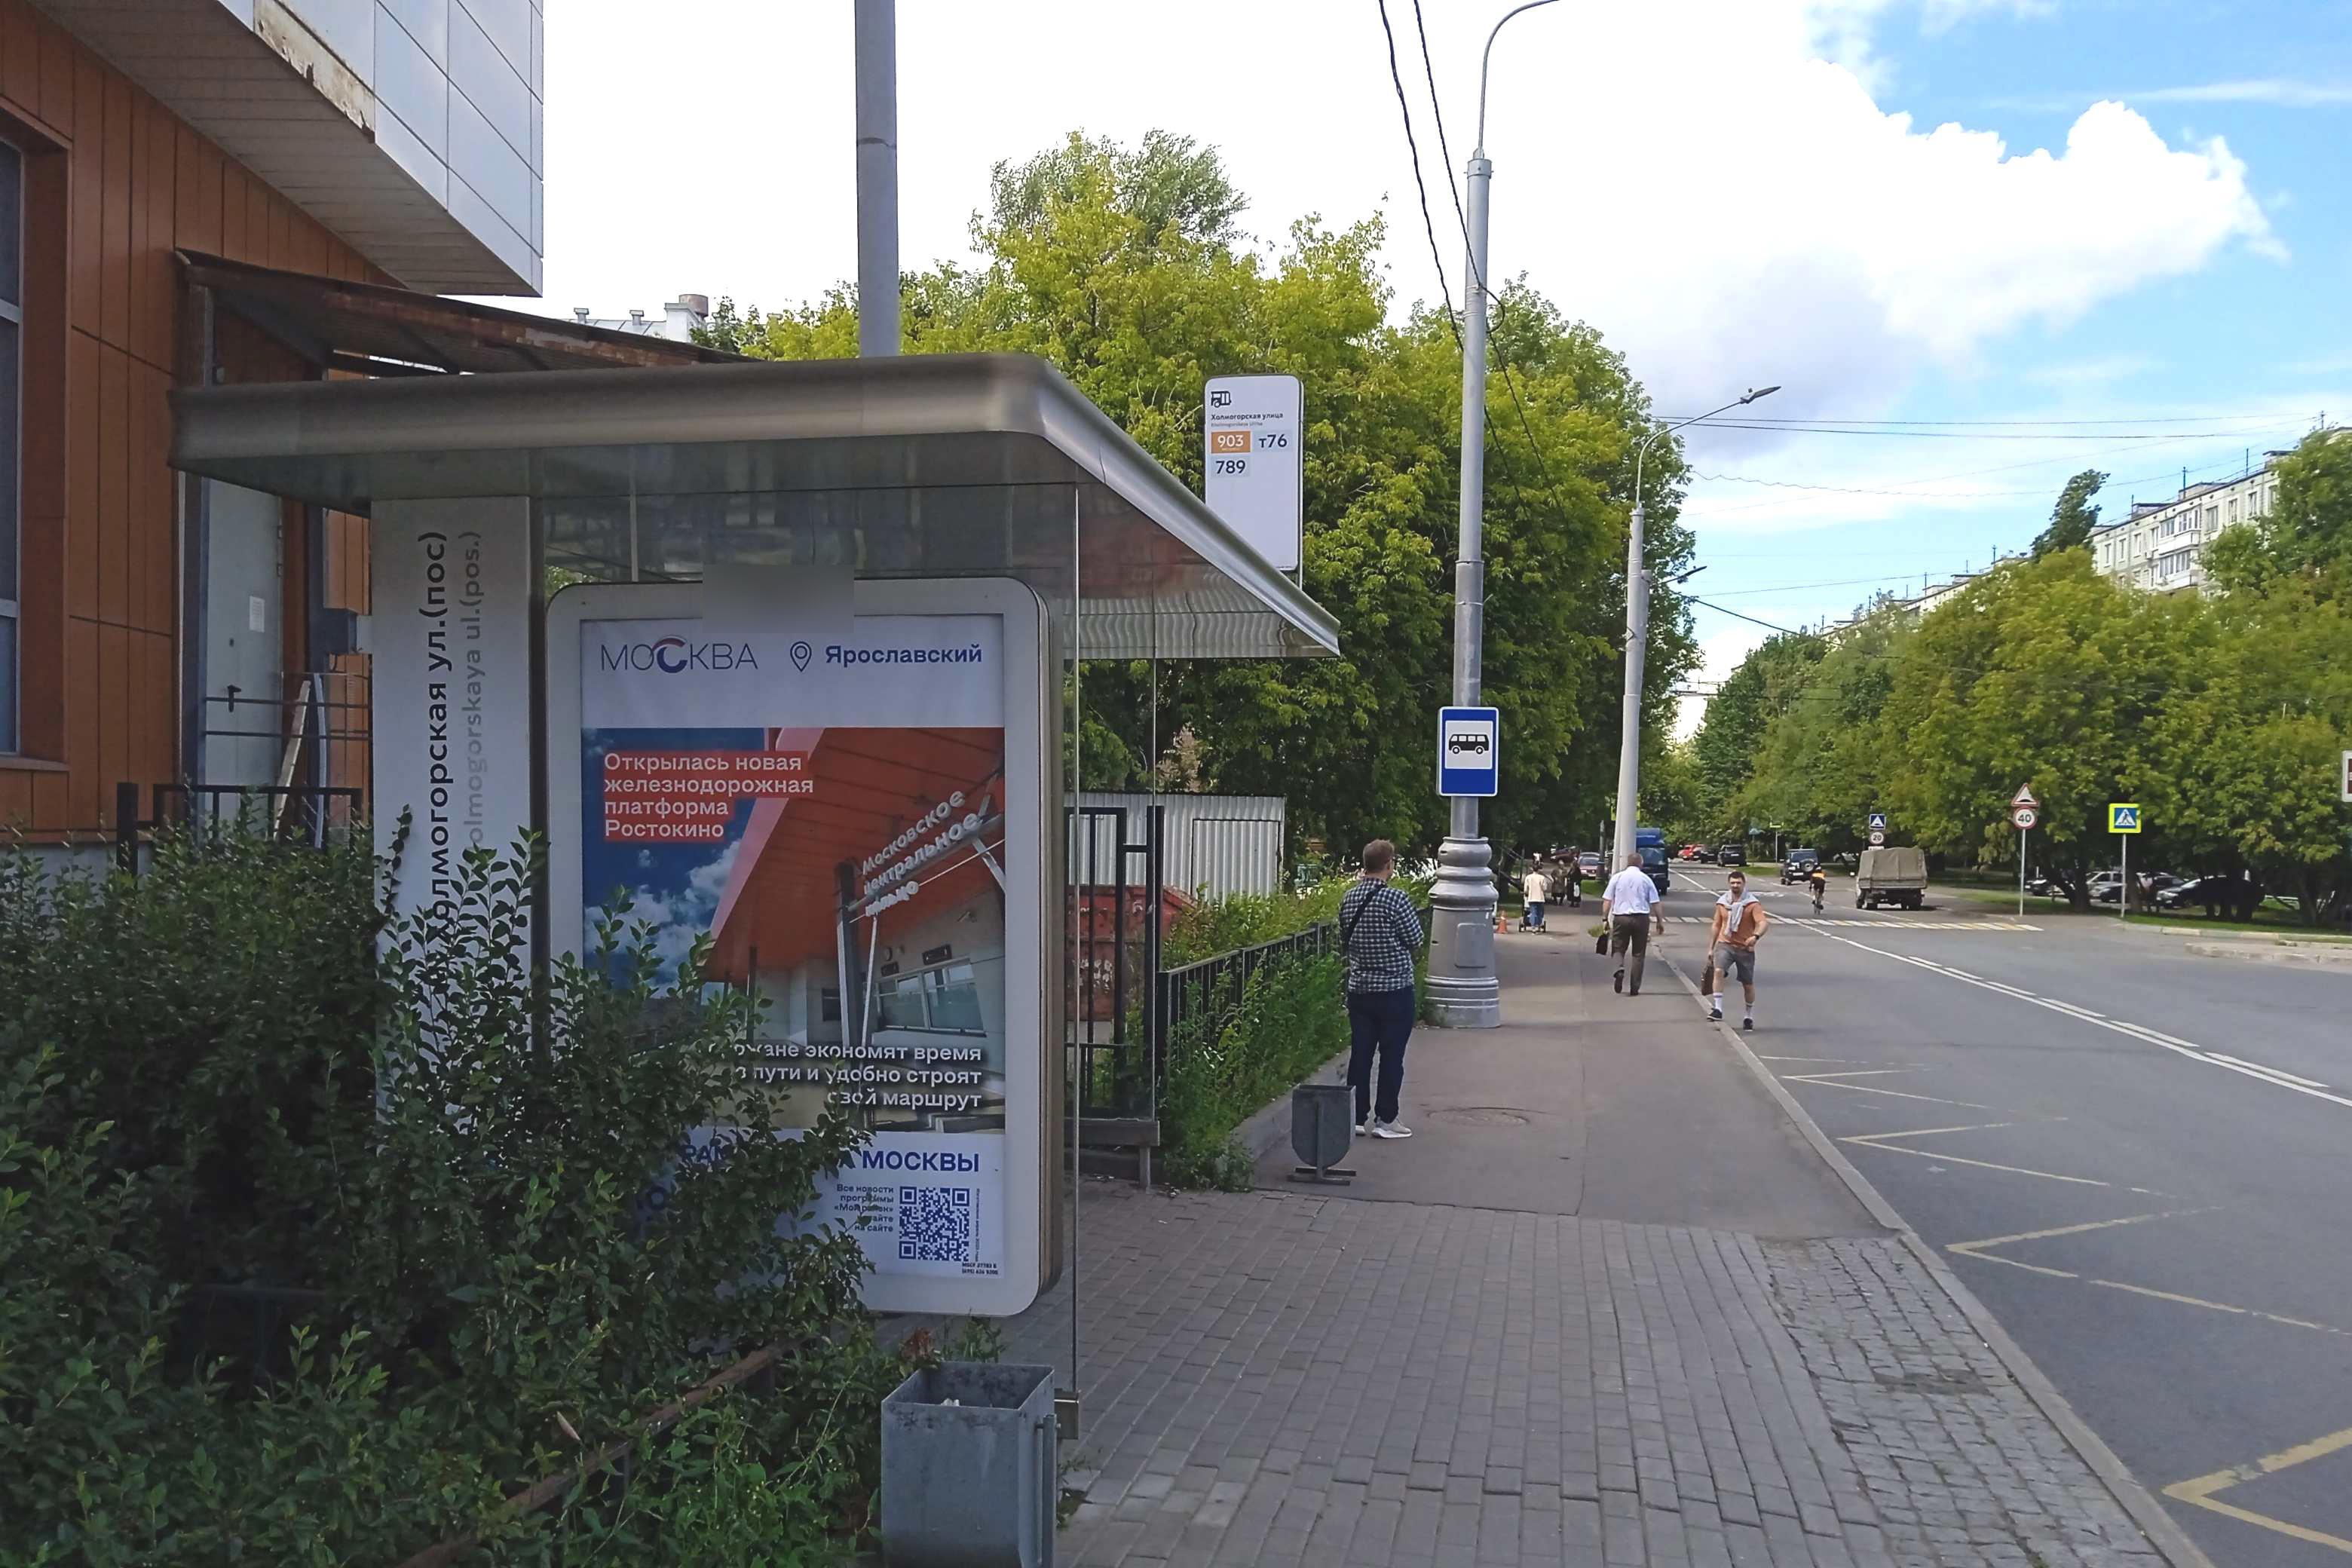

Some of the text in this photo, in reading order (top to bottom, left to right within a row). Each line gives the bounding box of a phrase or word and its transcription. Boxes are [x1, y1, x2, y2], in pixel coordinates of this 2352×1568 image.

[1217, 433, 1288, 448] 903 т76
[1215, 460, 1245, 474] 789
[418, 531, 452, 672] ул.(пос)
[601, 635, 758, 673] МОСКВА
[825, 644, 983, 668] Ярославский
[458, 531, 488, 846] olmogorskaya ul.(pos.)
[604, 754, 802, 773] Открылась новая
[604, 778, 814, 798] железнодорожная
[604, 797, 730, 819] платформа
[2017, 814, 2032, 822] 40
[605, 820, 725, 838] Ростокино
[805, 1045, 906, 1060] экономят
[914, 1046, 982, 1064] время
[754, 1066, 801, 1084] пути
[807, 1067, 819, 1080] и
[825, 1064, 901, 1085] удобно
[906, 1069, 982, 1087] строят
[883, 1093, 982, 1110] маршрут
[862, 1150, 979, 1172] МОСКВЫ
[837, 1184, 854, 1192] Все
[841, 1195, 894, 1203] прогрммы
[862, 1205, 894, 1213] рон»
[871, 1214, 894, 1223] айте
[867, 1224, 893, 1233] сайте
